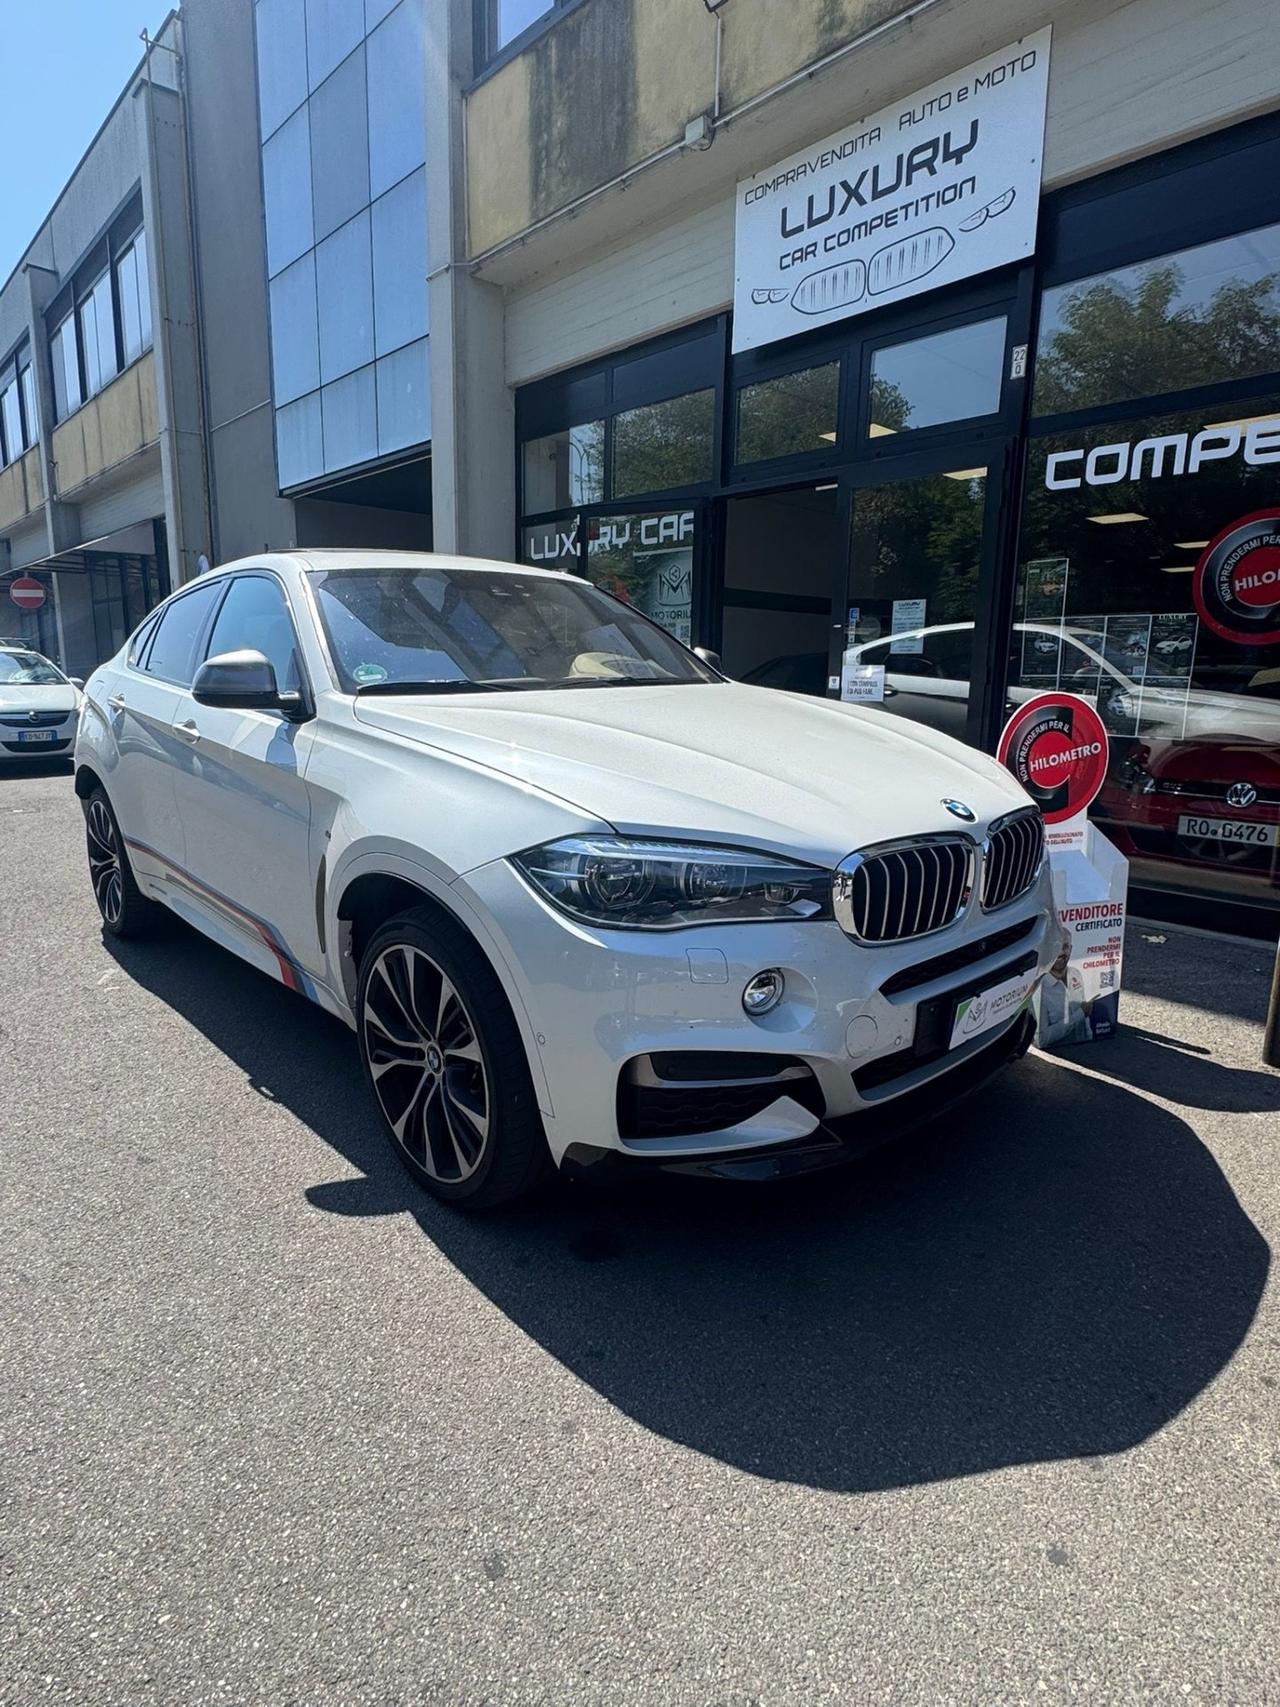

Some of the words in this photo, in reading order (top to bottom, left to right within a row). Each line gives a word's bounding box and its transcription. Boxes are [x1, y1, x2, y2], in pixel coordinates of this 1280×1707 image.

[744, 126, 881, 206] COMPRAVENDITA
[898, 92, 952, 131] AUTO
[956, 86, 969, 102] e
[974, 50, 1037, 96] MOTO
[779, 118, 979, 240] LUXURY
[779, 239, 818, 271] CAR
[823, 175, 976, 254] COMPETITION
[1220, 537, 1262, 582] PRENDERMI
[1220, 583, 1234, 602] NON
[1048, 720, 1063, 730] PER
[1062, 723, 1071, 734] IL
[1018, 722, 1049, 764] PRENDERMI
[1019, 763, 1030, 783] NON
[1075, 917, 1122, 933] CERTIFICATO
[1108, 935, 1121, 944] NON
[1087, 943, 1121, 954] PRENDERMI
[1103, 951, 1114, 959] PER
[1082, 957, 1120, 970] CHILOMETRO
